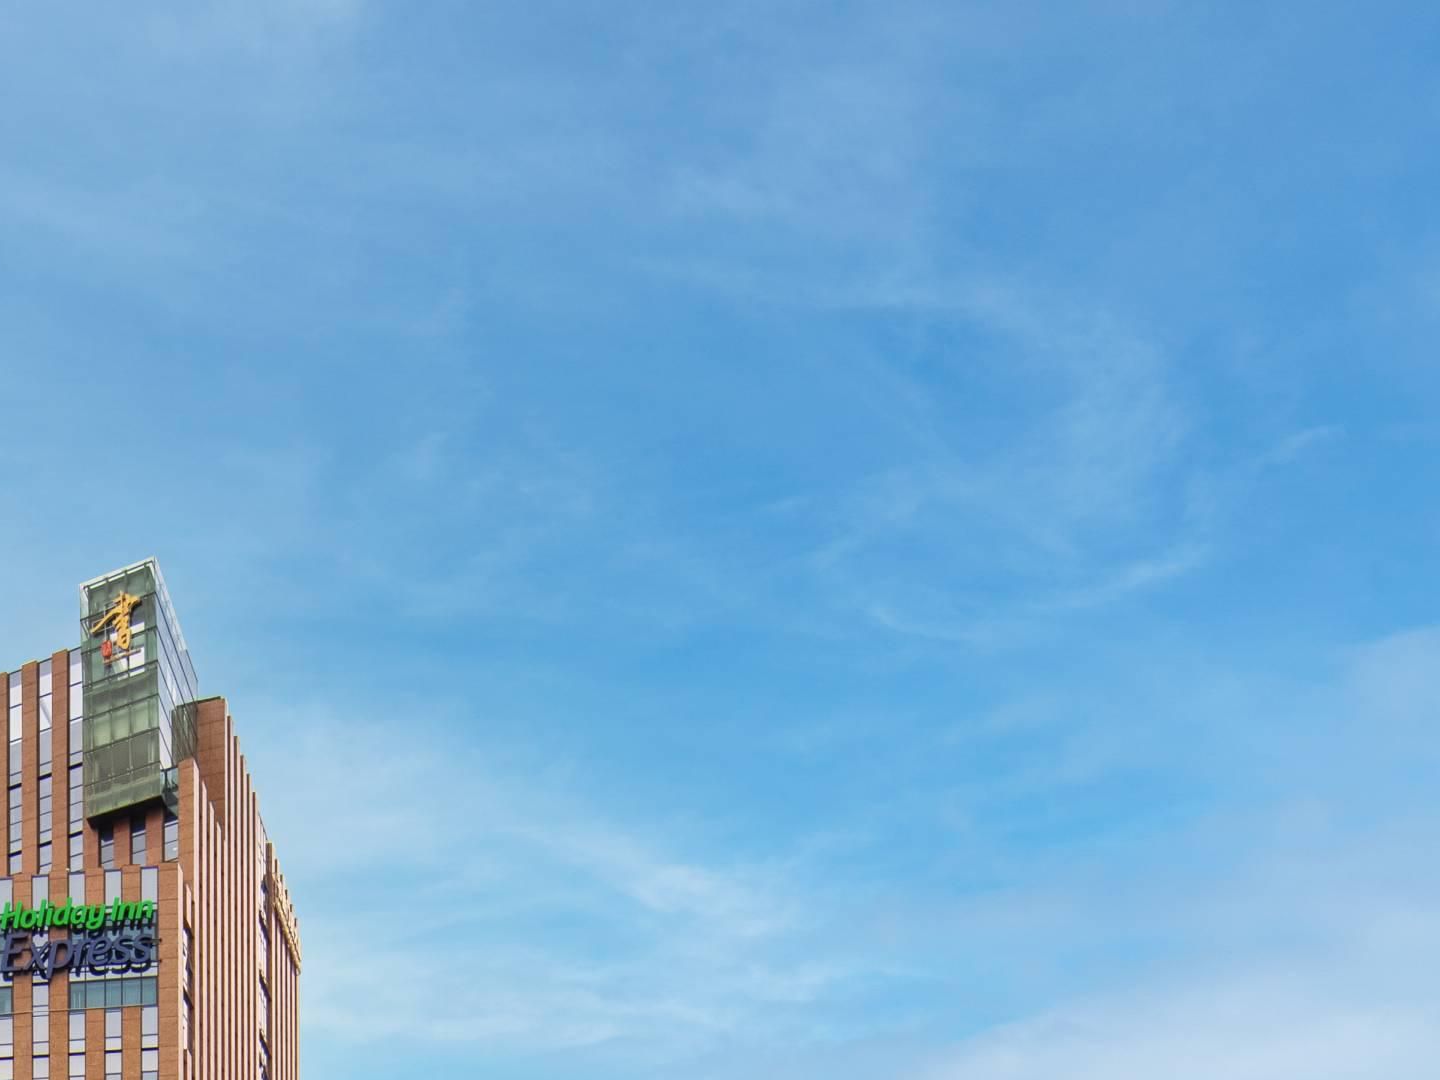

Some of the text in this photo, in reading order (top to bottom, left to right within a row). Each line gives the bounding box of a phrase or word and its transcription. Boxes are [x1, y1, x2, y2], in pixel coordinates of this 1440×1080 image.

[0, 896, 153, 929] Holiday Inn
[0, 930, 153, 979] Express
